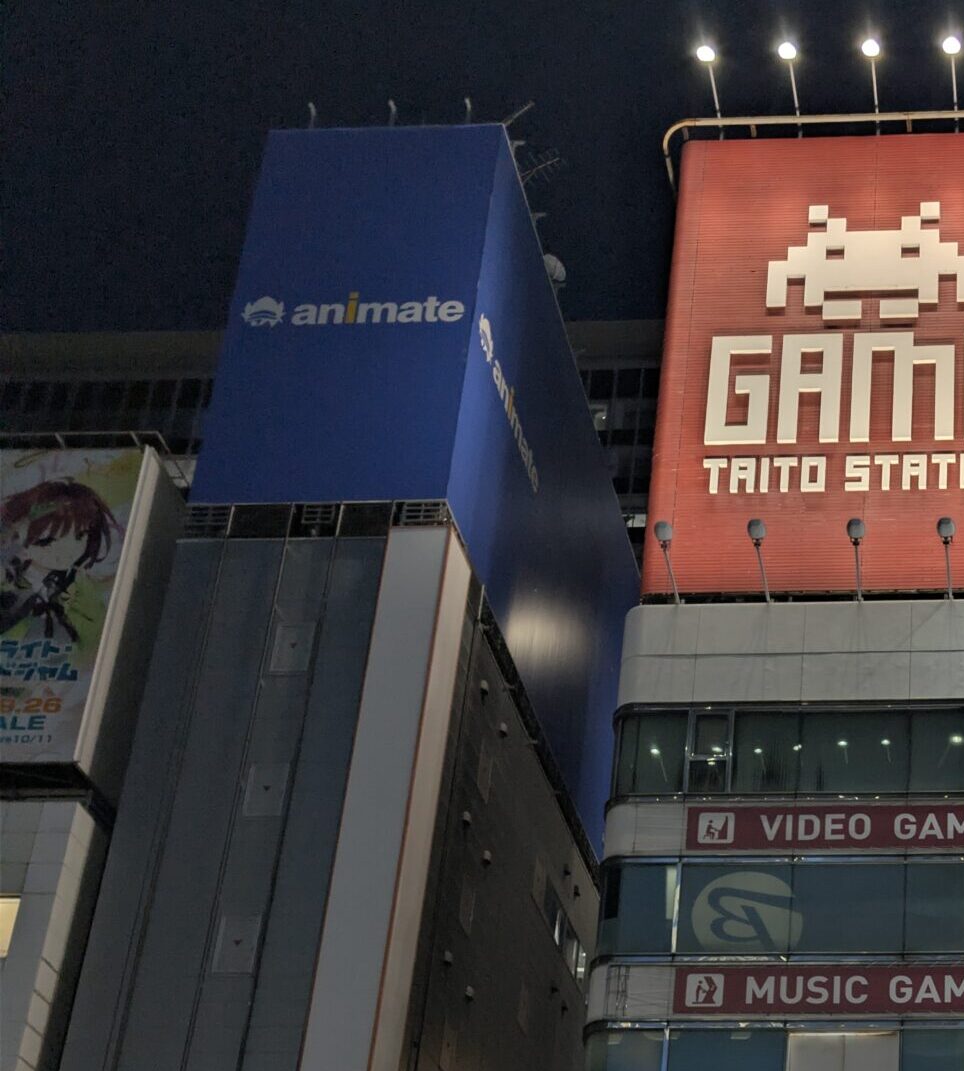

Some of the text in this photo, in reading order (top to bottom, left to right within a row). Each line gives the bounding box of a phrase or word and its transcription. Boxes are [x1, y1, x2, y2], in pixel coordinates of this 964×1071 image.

[291, 292, 465, 325] animate
[493, 359, 540, 494] animate
[703, 456, 826, 494] TAITO
[760, 812, 872, 841] VIDEO
[745, 974, 870, 1005] MUSIC
